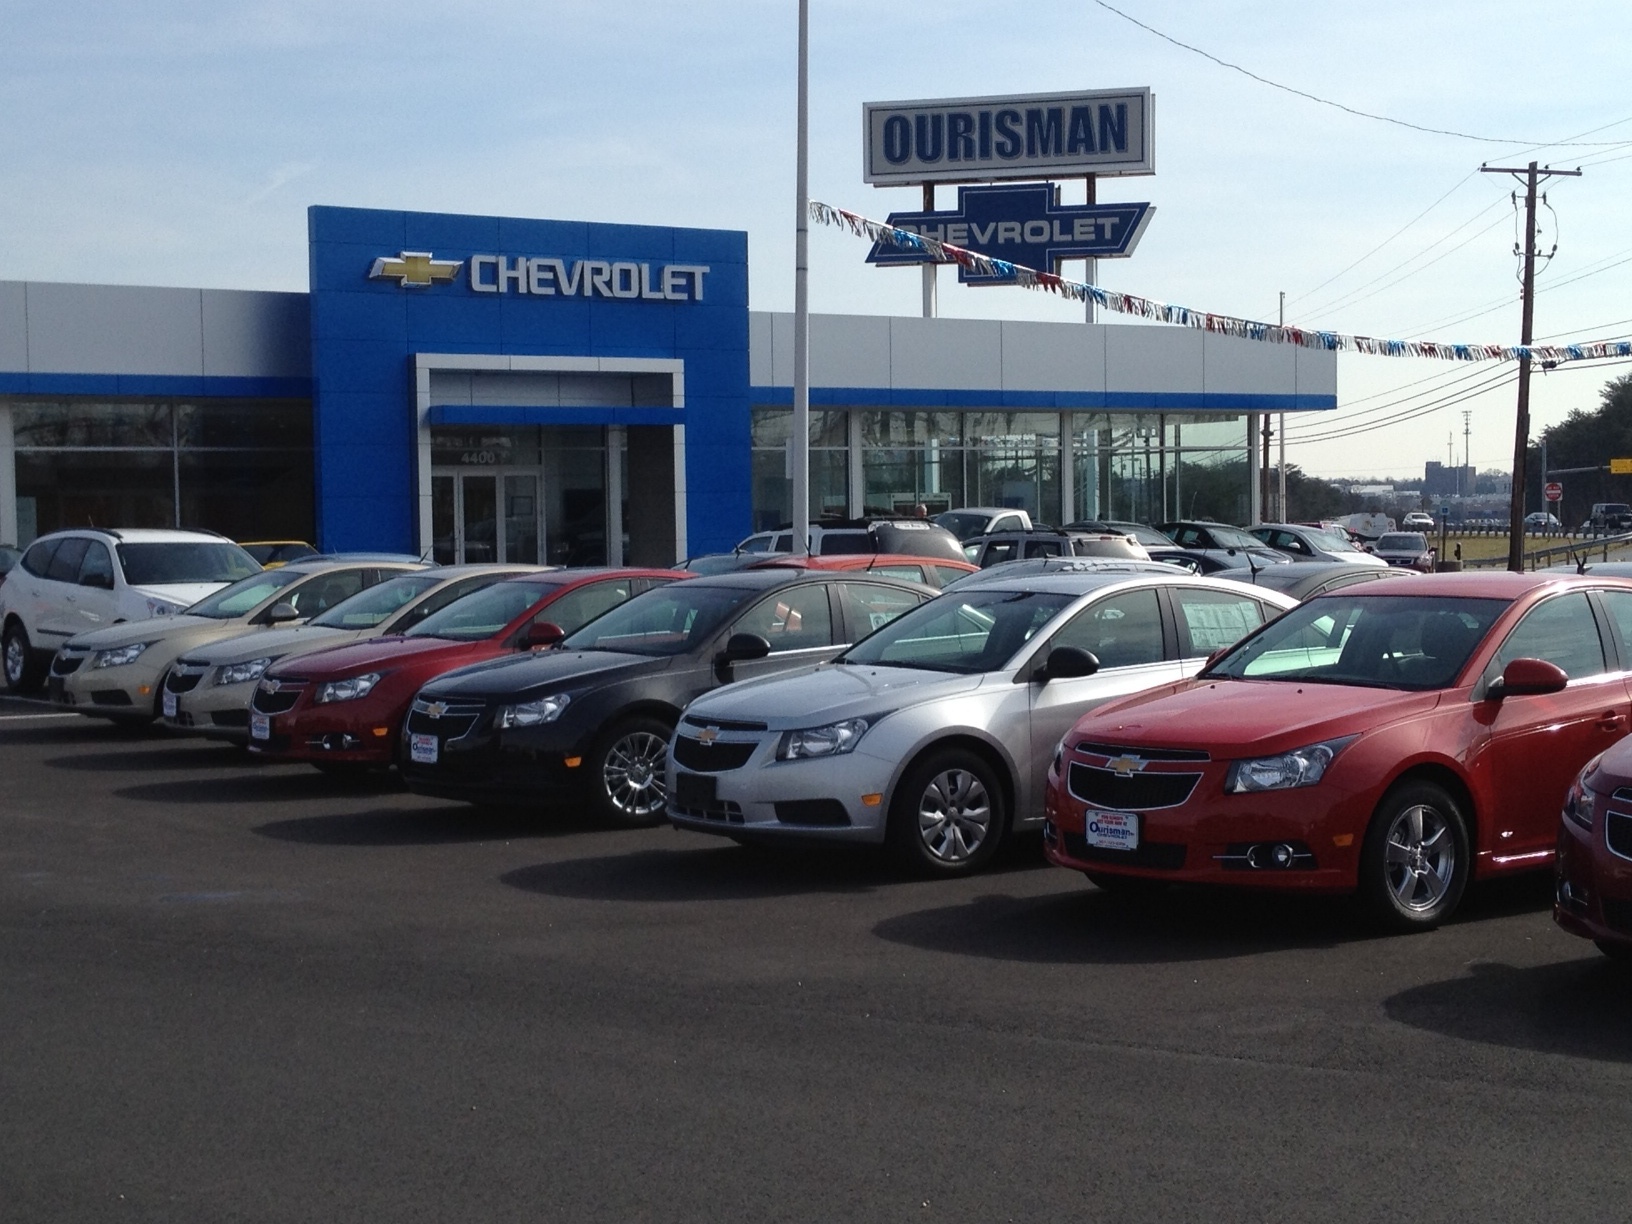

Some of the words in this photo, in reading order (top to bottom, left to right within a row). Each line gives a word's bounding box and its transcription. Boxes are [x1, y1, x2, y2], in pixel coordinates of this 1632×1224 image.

[882, 103, 1129, 166] OURISMAN
[470, 254, 711, 301] CHEVROLET
[461, 451, 496, 464] 4400
[1089, 821, 1131, 837] Ourisman
